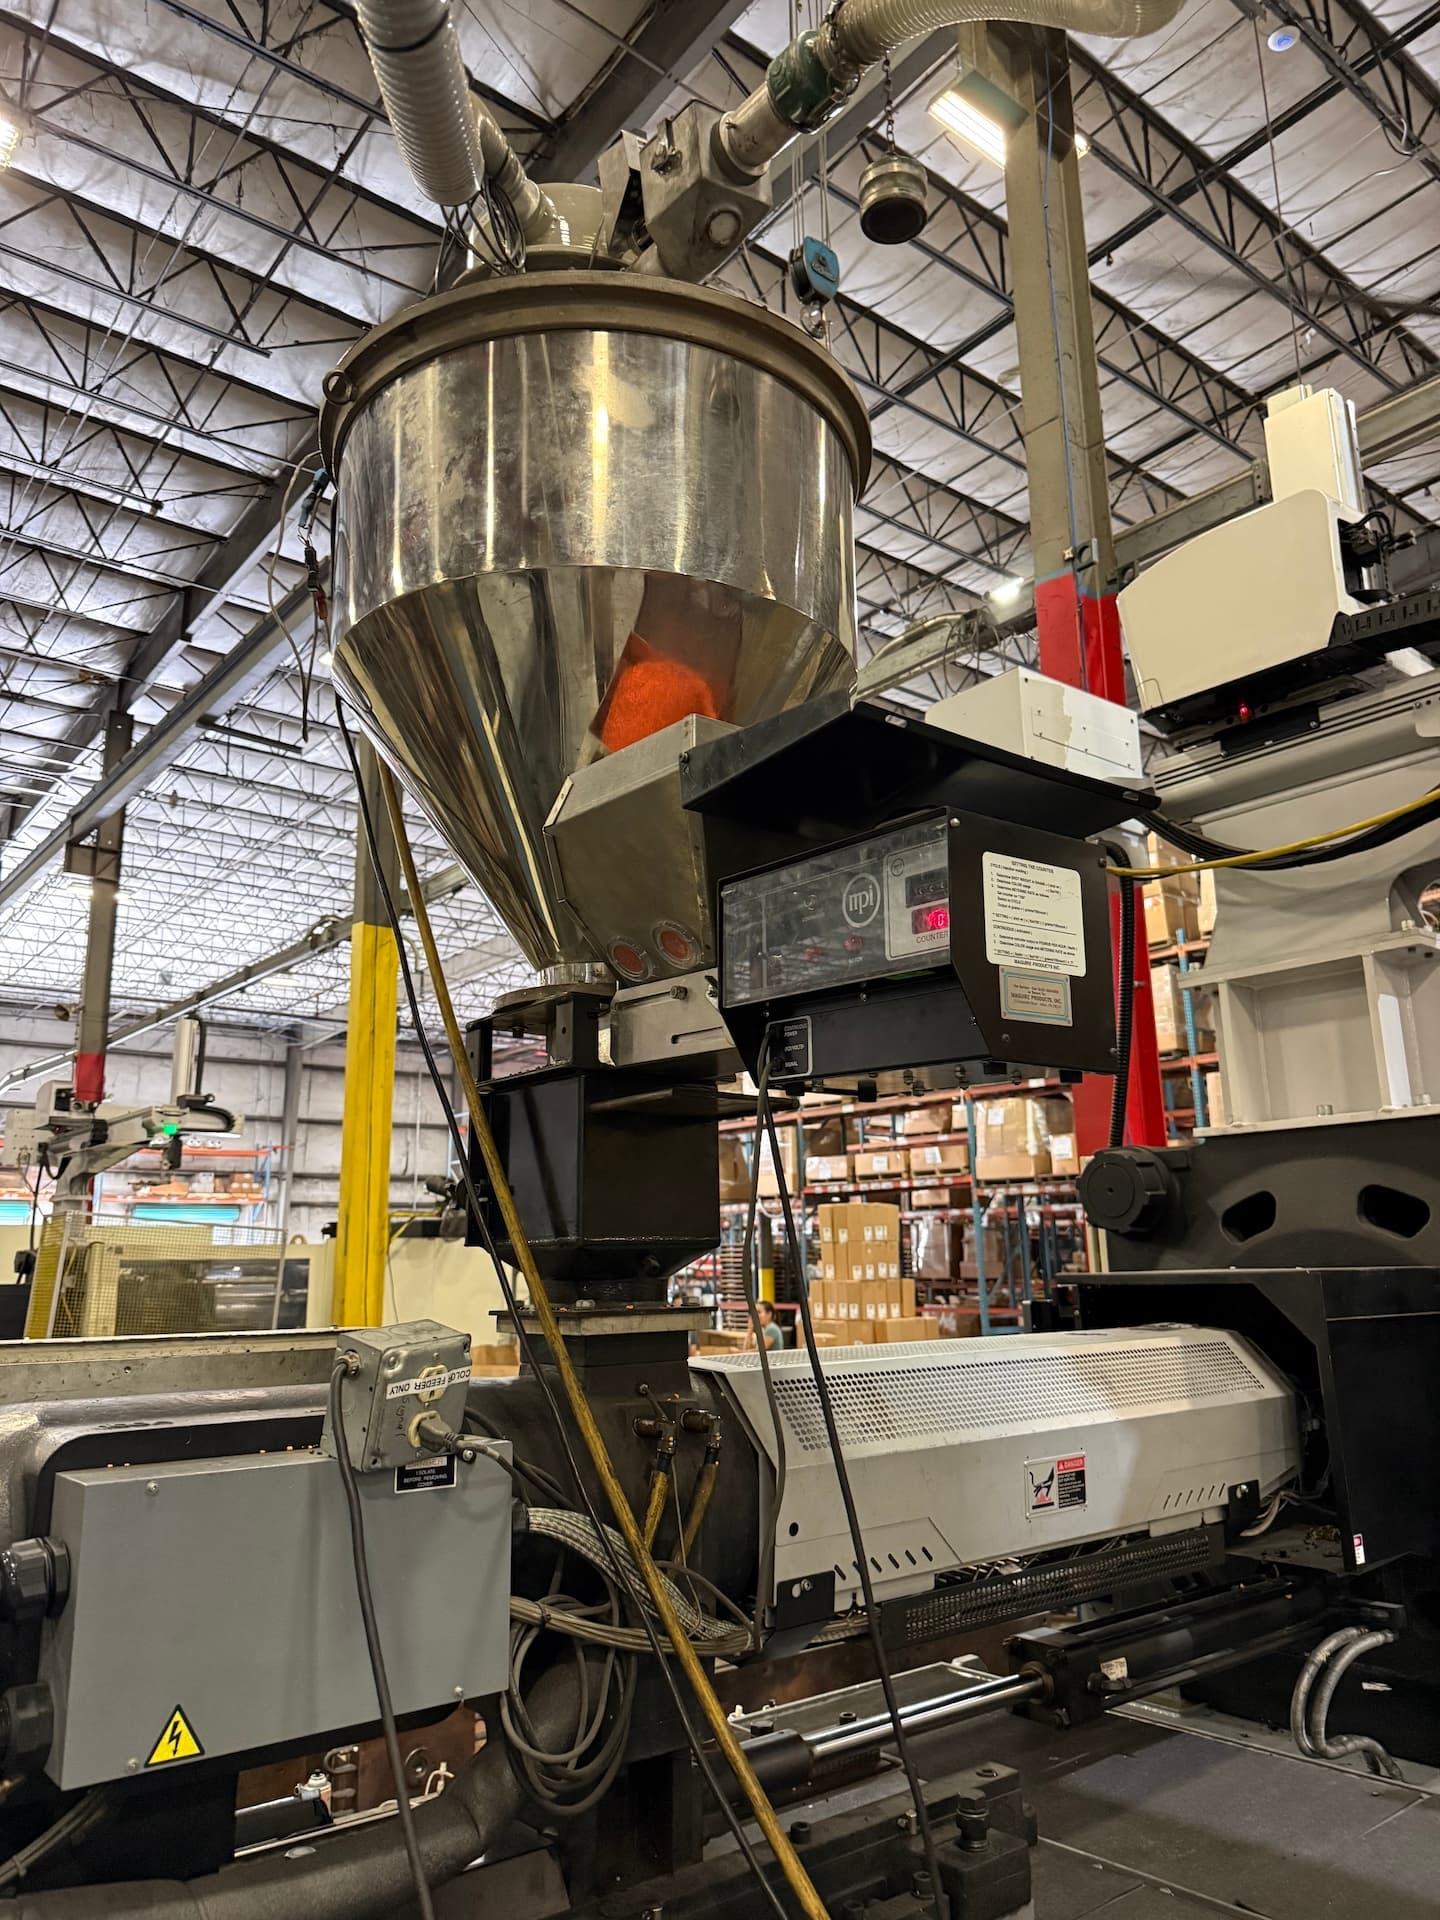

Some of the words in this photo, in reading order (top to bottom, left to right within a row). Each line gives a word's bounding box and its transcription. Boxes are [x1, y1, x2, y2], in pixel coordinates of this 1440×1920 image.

[1032, 961, 1052, 969] PRODUCTS
[447, 1368, 471, 1382] COLOR
[388, 1383, 410, 1396] ONLY
[414, 1378, 446, 1390] FEEDER
